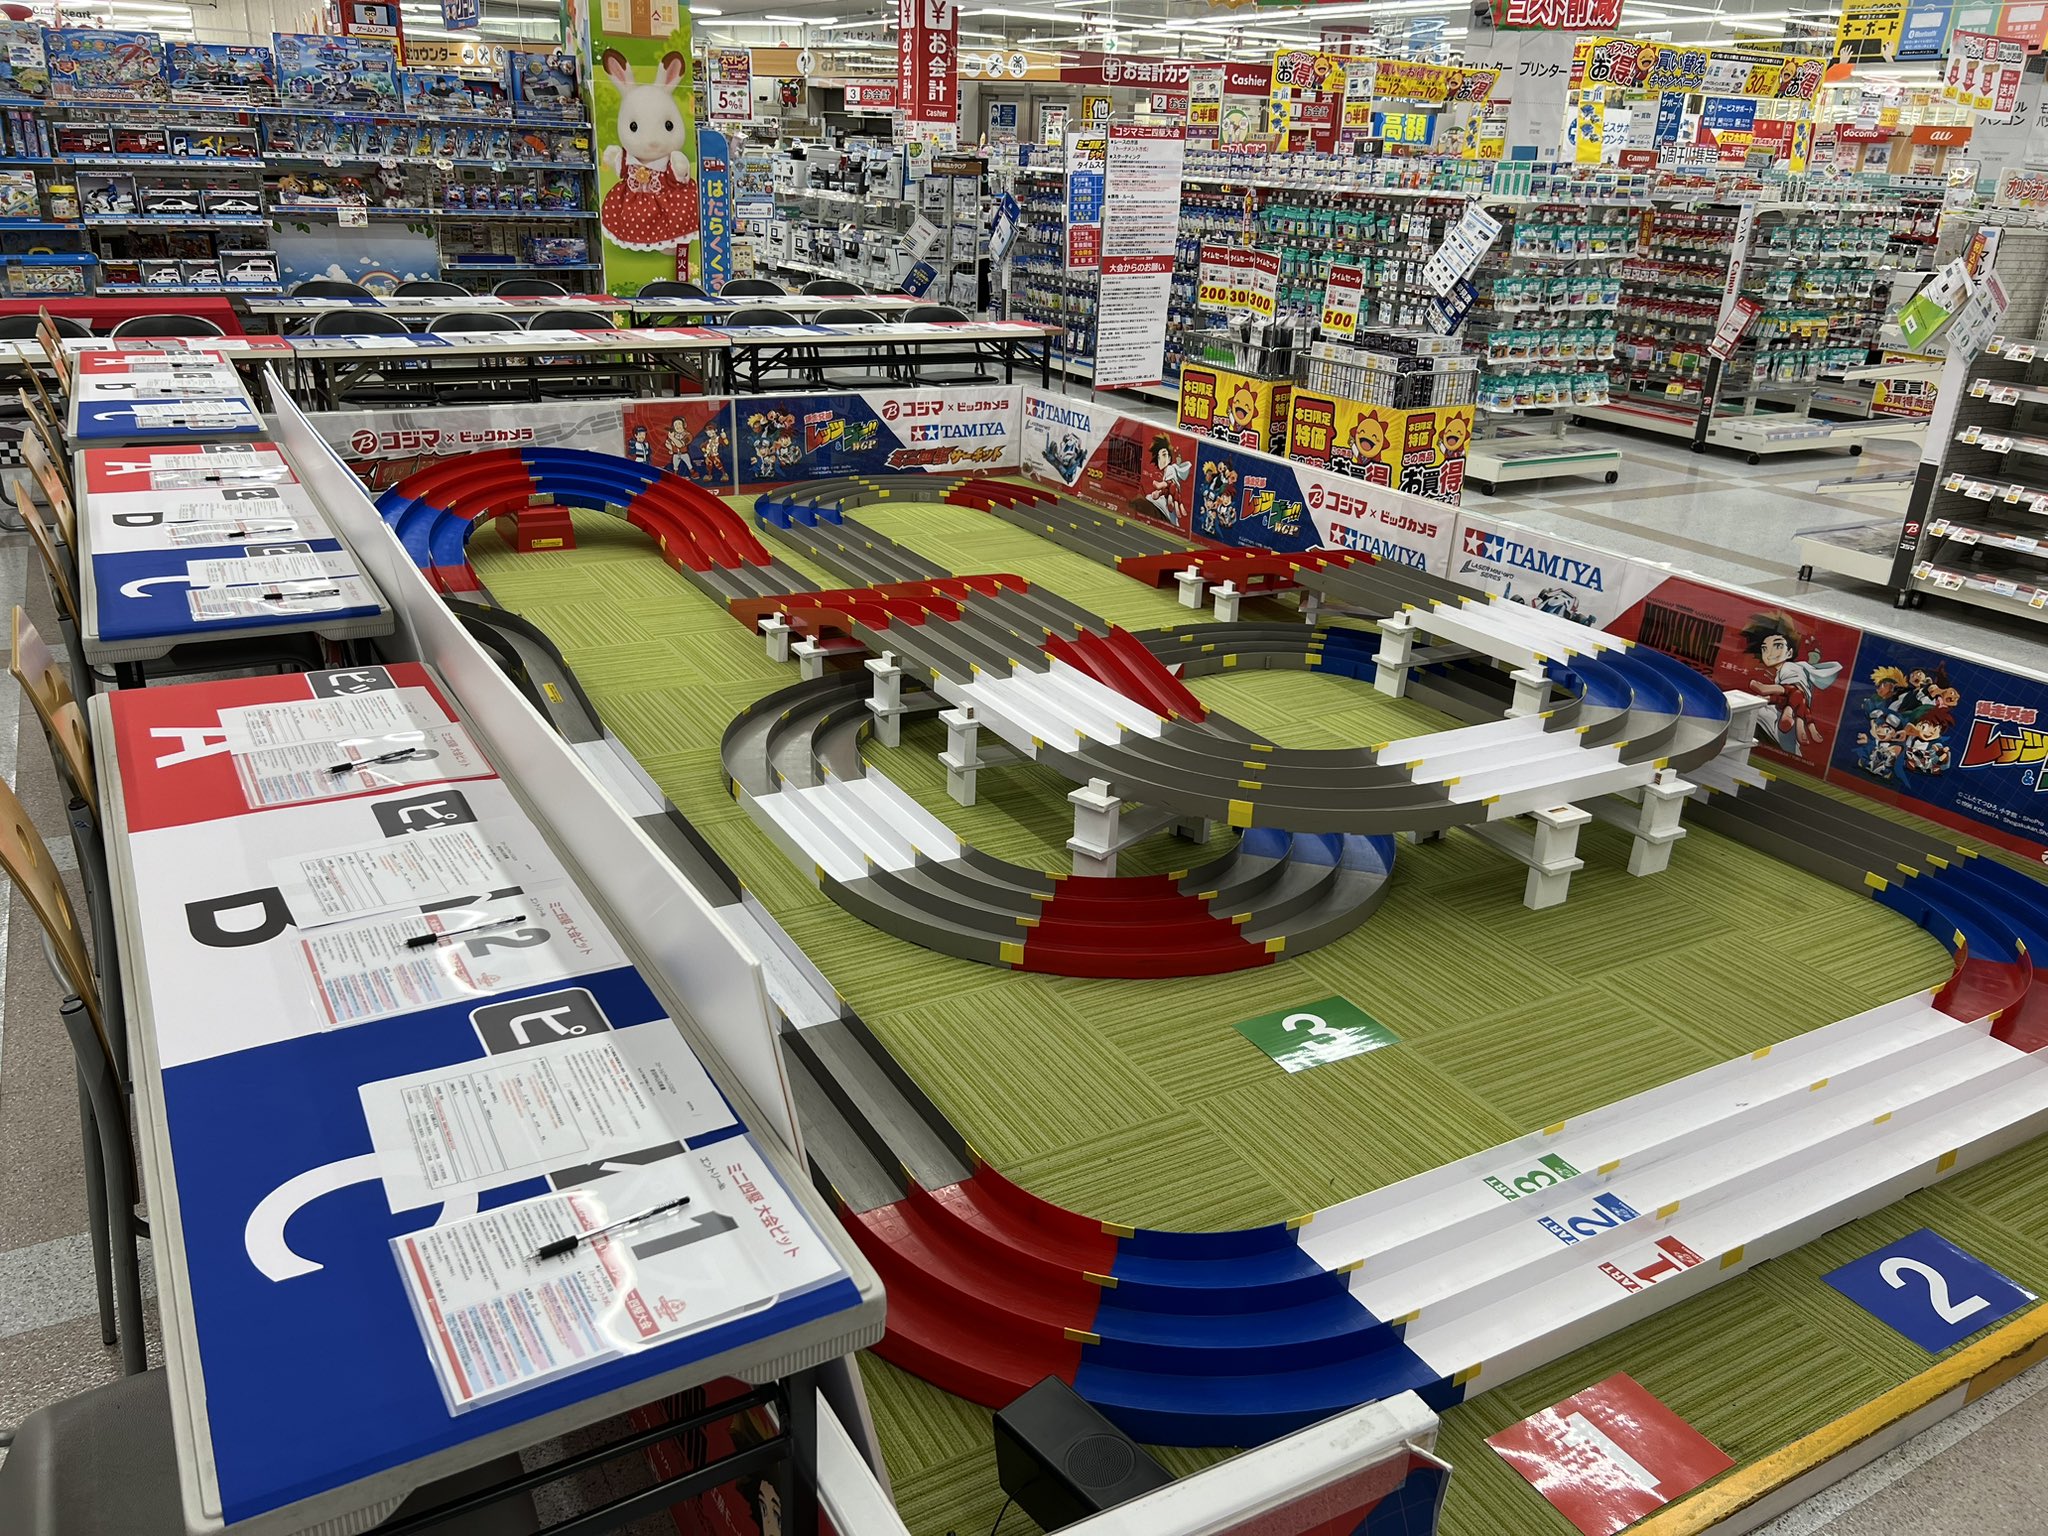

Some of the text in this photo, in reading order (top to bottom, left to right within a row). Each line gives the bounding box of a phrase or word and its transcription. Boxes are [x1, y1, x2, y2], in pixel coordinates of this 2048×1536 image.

[355, 24, 390, 35] ゲームソフト
[1843, 20, 1899, 37] キーボード
[405, 45, 458, 62] カウンター
[902, 31, 913, 101] お会計
[928, 32, 948, 102] お会計
[1519, 62, 1568, 78] プリンター
[1231, 73, 1268, 87] Cashier
[1648, 73, 1703, 90] キャンペーン
[850, 88, 891, 101] 3 お会計
[1156, 96, 1165, 109] 2
[925, 108, 949, 119] Cashier
[1304, 105, 1330, 117] お会計
[1115, 127, 1180, 138] コジマミニ四駆大会
[1382, 111, 1428, 142] 高額
[1843, 129, 1879, 138] docomo
[1930, 131, 1954, 141] au
[1627, 155, 1650, 163] Canon
[1202, 250, 1228, 260] タイムセール
[1255, 256, 1279, 271] タイムセール
[1109, 262, 1166, 273] 大会からのお願い
[1331, 271, 1362, 284] タイムセール
[1726, 260, 1741, 295] Canon
[1200, 286, 1227, 299] 200
[1250, 293, 1271, 311] 300
[1323, 310, 1353, 328] 500
[1184, 380, 1214, 397] 本日限定
[903, 401, 944, 418] コジマ
[957, 400, 1009, 413] ビックカメラ
[1184, 395, 1210, 420] 特価
[1045, 404, 1092, 433] TAMIYA
[1295, 407, 1332, 426] 本日限定
[940, 422, 1007, 439] TAMIYA
[1408, 421, 1433, 432] 本日限定
[381, 428, 441, 450] コジマ
[459, 427, 535, 443] ビックカメラ
[1295, 424, 1328, 451] 特価
[1408, 432, 1430, 448] 特価
[1403, 450, 1435, 465] この商品
[1325, 490, 1369, 519] コジマ
[1380, 509, 1438, 539] ビックカメラ
[1358, 534, 1427, 572] TAMIYA
[1505, 541, 1604, 593] TAMIYA
[1479, 571, 1502, 582] SERIES
[150, 727, 233, 769] A
[1973, 805, 2000, 821] KOSHITA
[1514, 1170, 1558, 1194] 3
[726, 1162, 801, 1258] ミニ四駆 大会ピット
[1567, 1207, 1620, 1237] 2
[631, 1210, 739, 1261] 1
[1632, 1252, 1683, 1284] 1
[1879, 1255, 1992, 1326] 2
